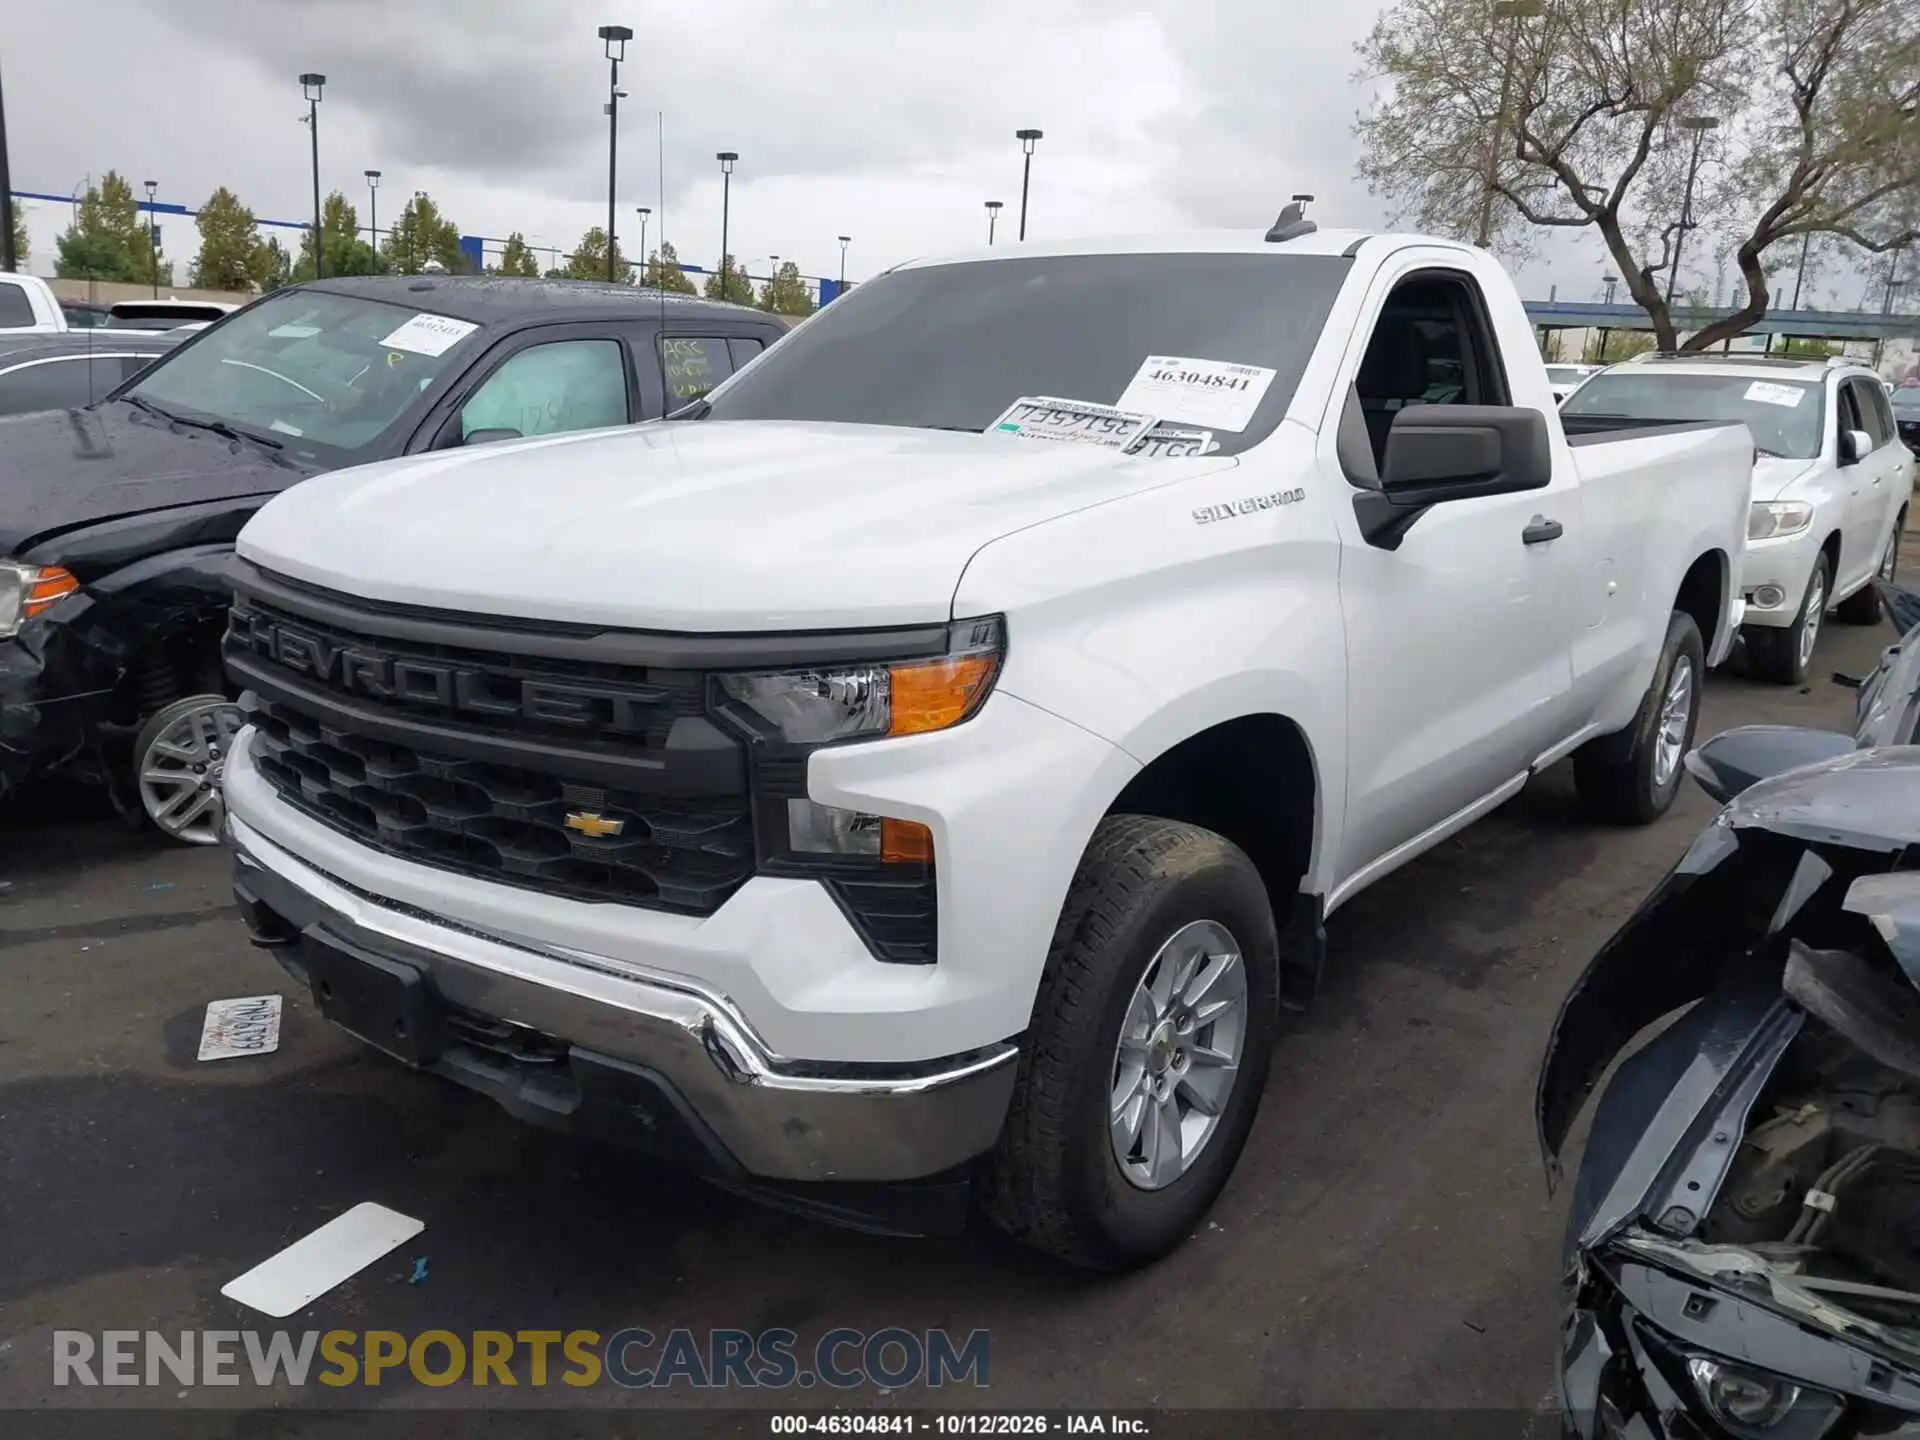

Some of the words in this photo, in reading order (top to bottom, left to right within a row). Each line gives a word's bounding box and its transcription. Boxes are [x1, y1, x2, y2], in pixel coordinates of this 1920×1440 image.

[1149, 369, 1251, 391] 46304841
[1192, 488, 1306, 525] SILVERADO
[228, 605, 669, 735] CHEVROLET
